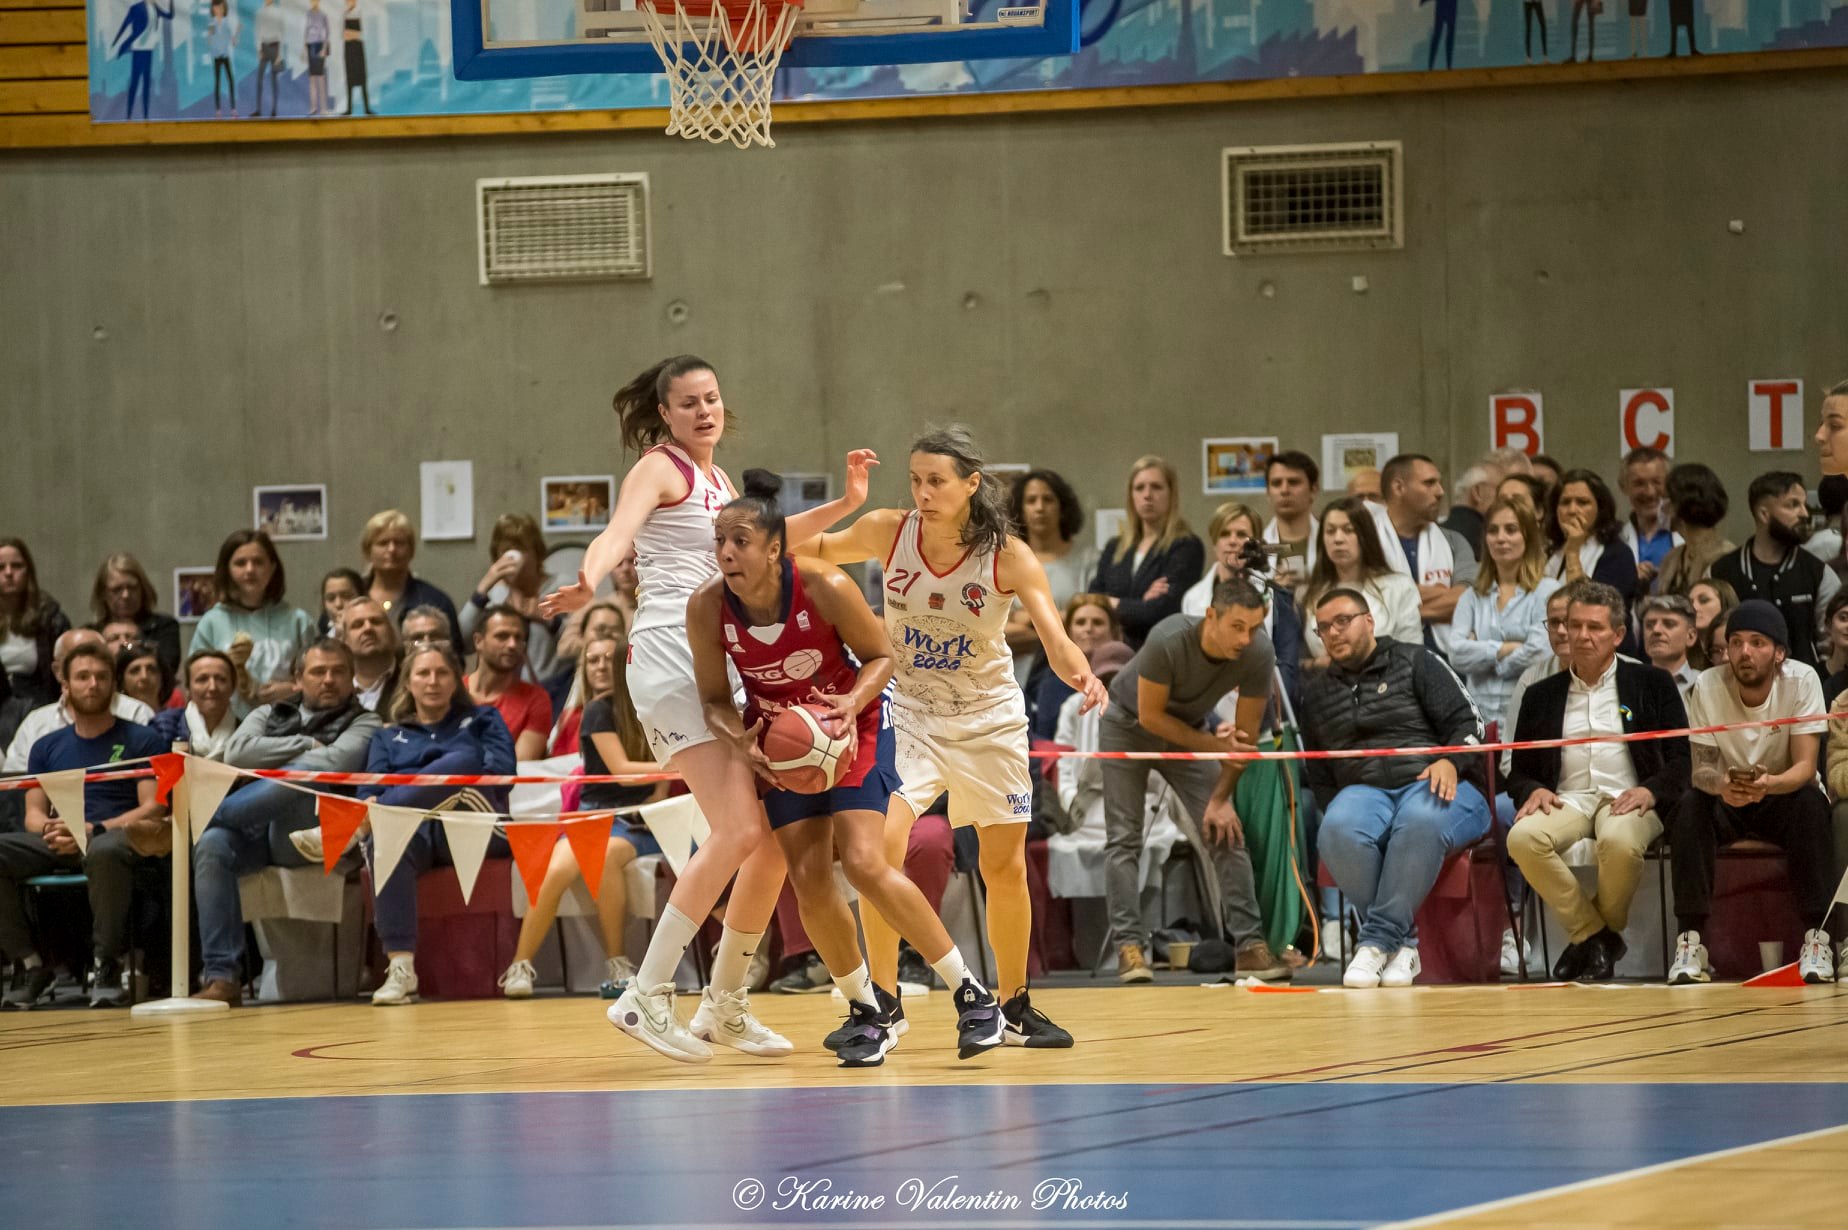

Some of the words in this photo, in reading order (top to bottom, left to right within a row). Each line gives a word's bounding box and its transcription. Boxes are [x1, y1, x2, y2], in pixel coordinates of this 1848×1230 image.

[1495, 396, 1540, 456] B
[1624, 390, 1670, 452] C
[1754, 382, 1798, 448] T
[887, 569, 921, 597] 21
[904, 624, 977, 658] Work
